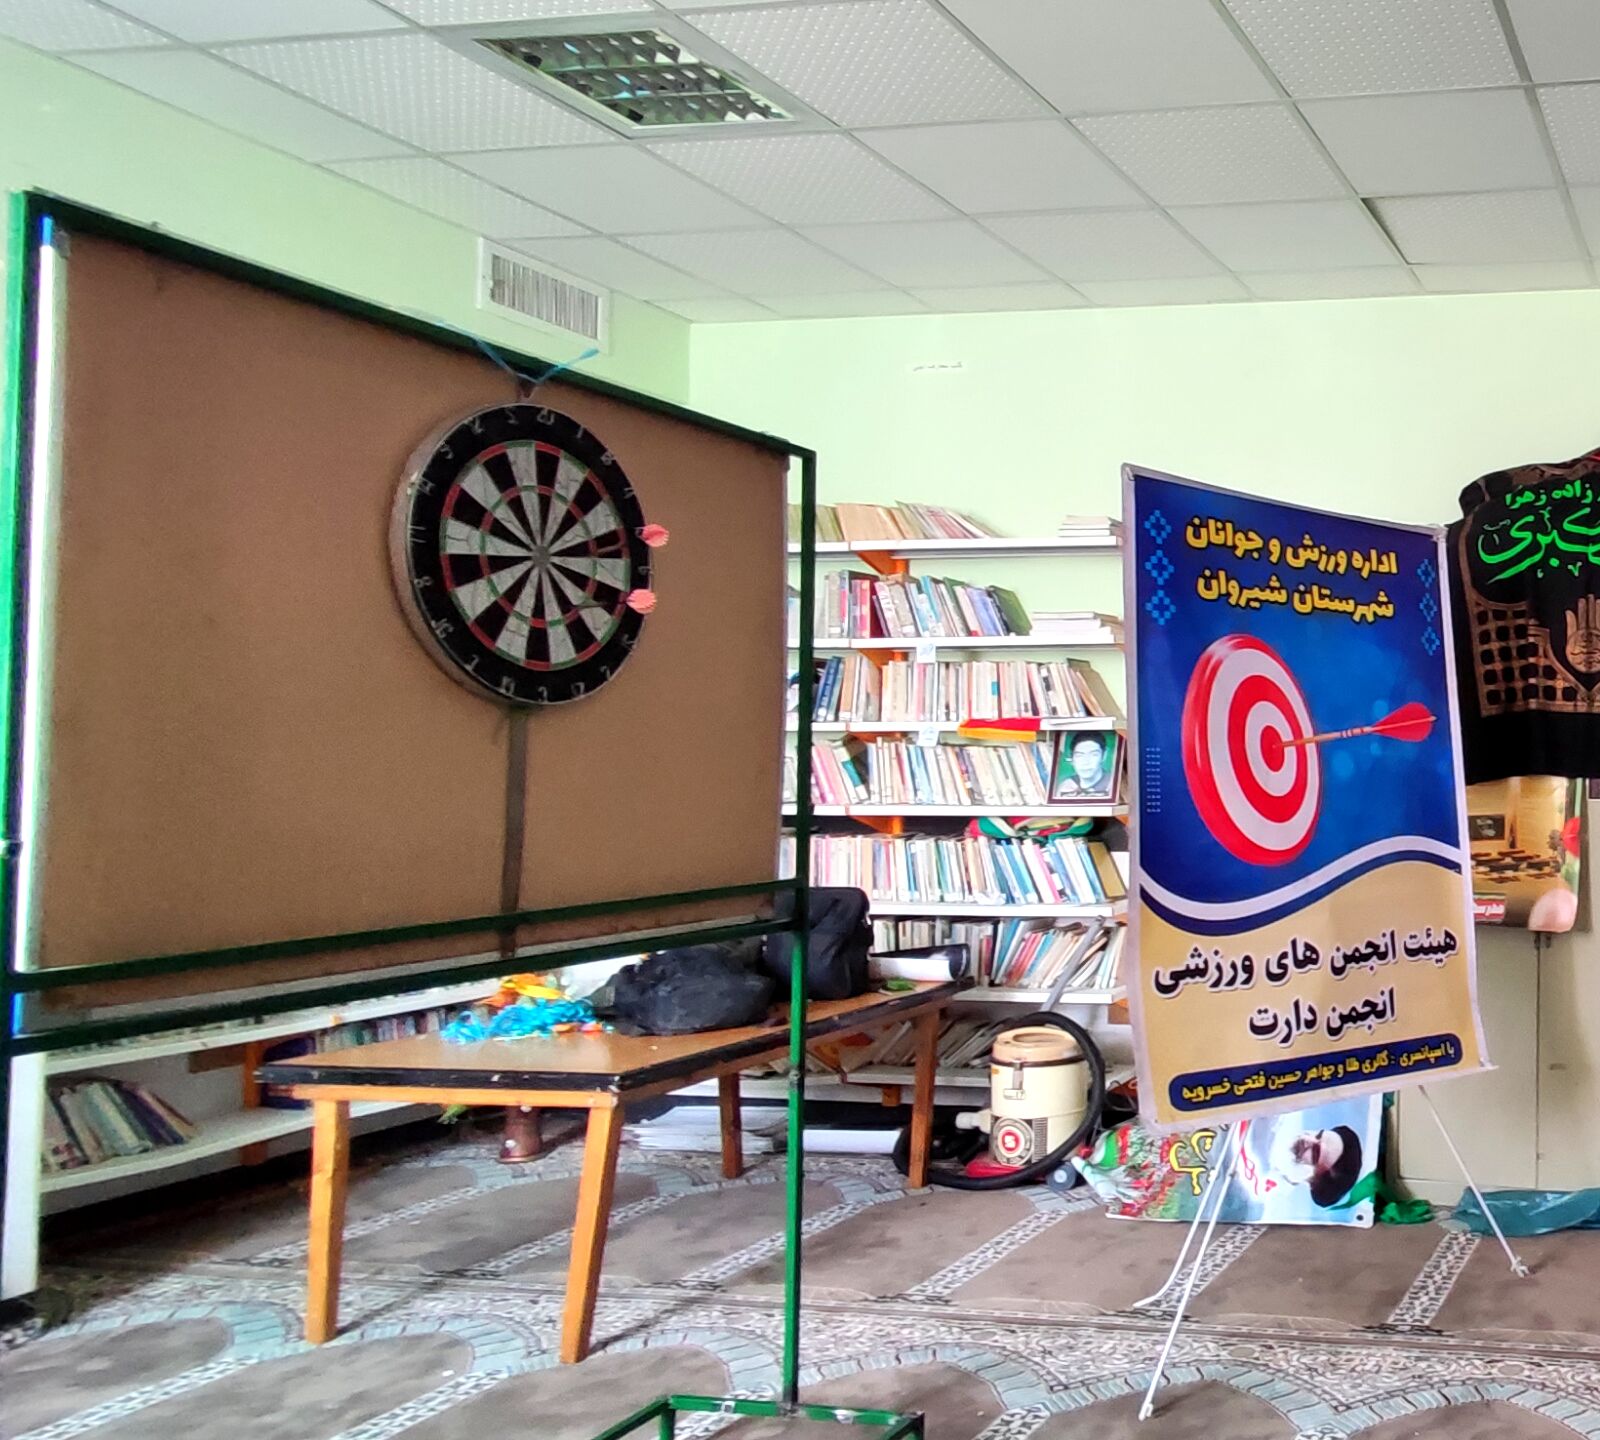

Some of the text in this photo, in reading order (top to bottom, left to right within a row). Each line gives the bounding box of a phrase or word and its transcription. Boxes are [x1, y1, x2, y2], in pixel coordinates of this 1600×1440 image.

[1184, 516, 1399, 580] اداره ورزش و جوانان
[1196, 568, 1395, 624] شهرستان شیروان
[1153, 927, 1458, 995] هیئت انجمن های ورزشی
[1249, 987, 1396, 1045] انجمن دارت
[1400, 1043, 1446, 1067] اسپانسری
[1446, 1041, 1455, 1058] با
[1233, 1070, 1266, 1096] فتحی
[1267, 1070, 1302, 1090] حسین
[1336, 1063, 1344, 1078] و
[1181, 1077, 1232, 1102] خسرویه
